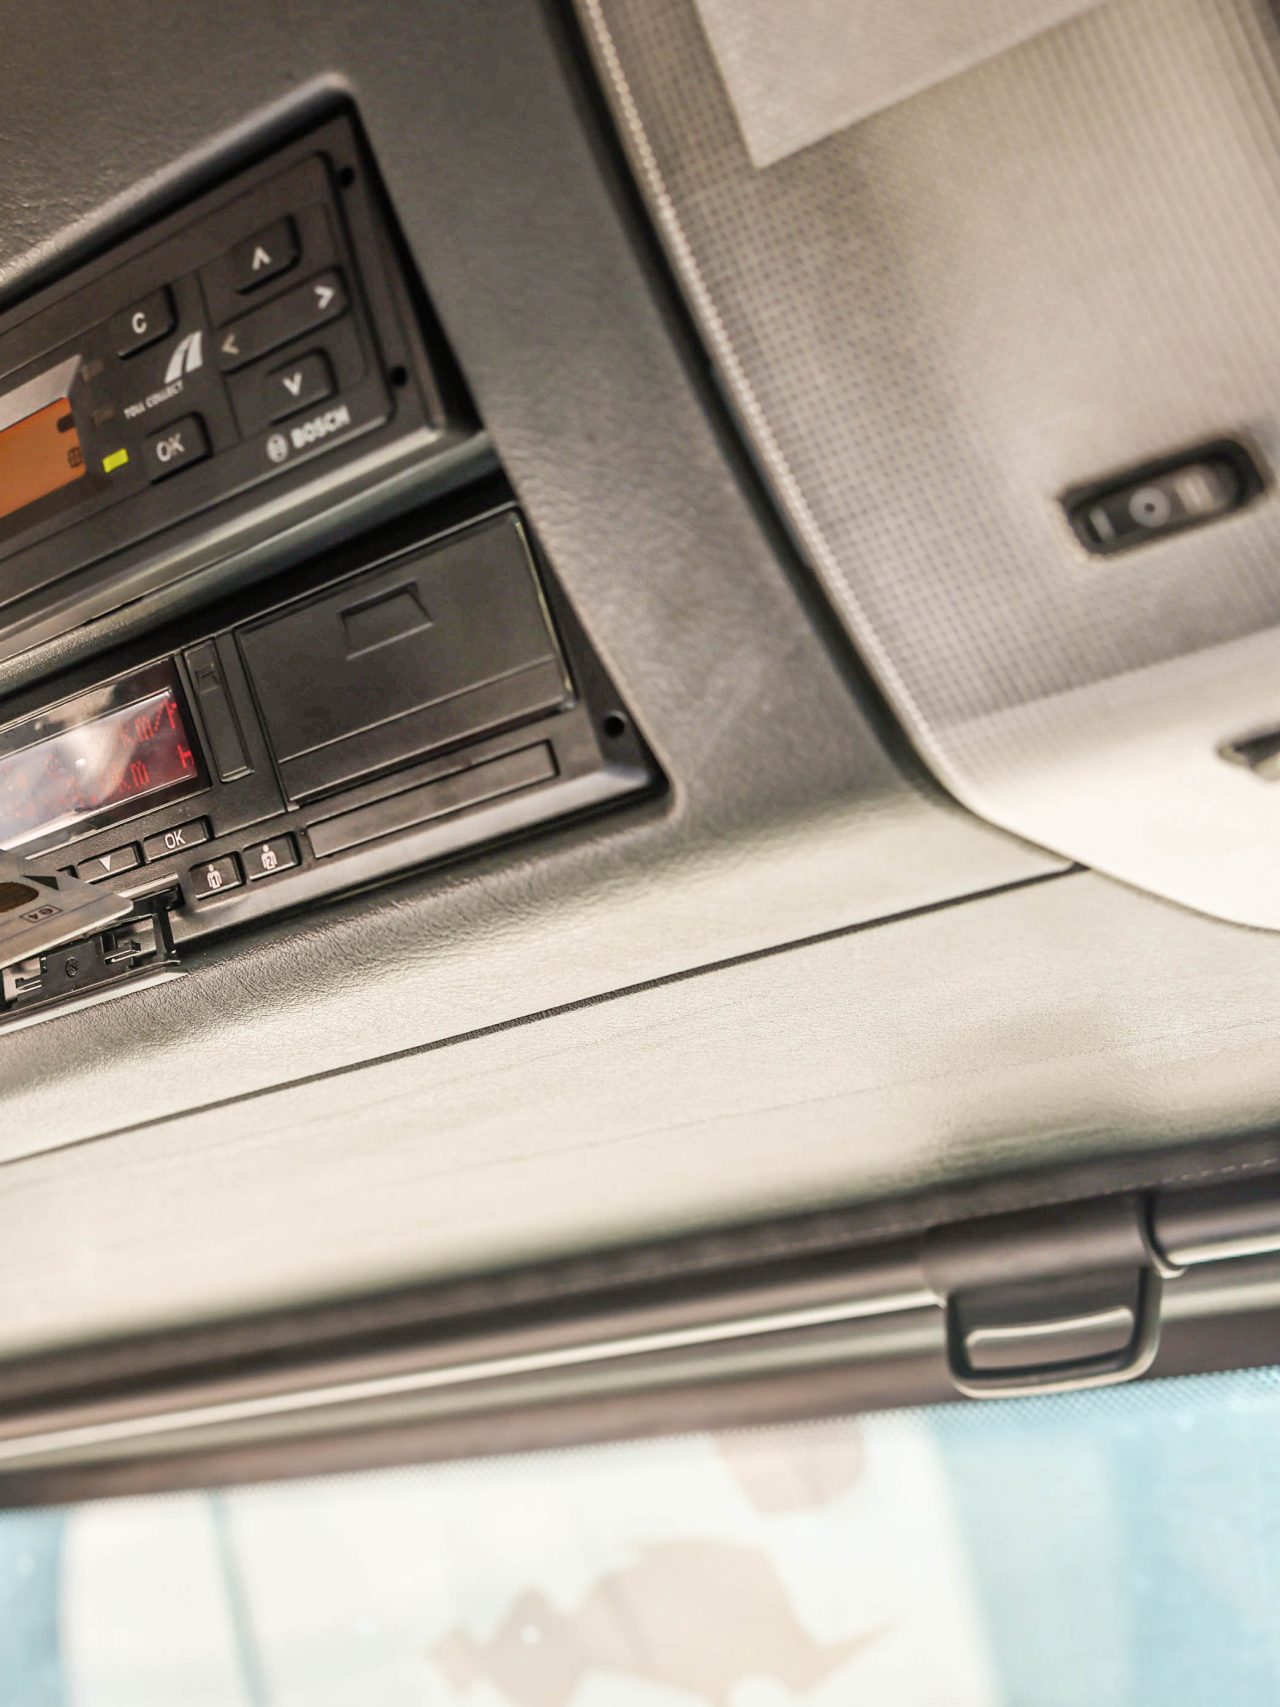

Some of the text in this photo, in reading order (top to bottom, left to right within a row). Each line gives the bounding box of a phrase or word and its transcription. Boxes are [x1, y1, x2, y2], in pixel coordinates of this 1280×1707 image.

[131, 312, 147, 334] C
[290, 405, 351, 449] BOSCH
[156, 433, 185, 462] OK
[164, 829, 187, 849] OK
